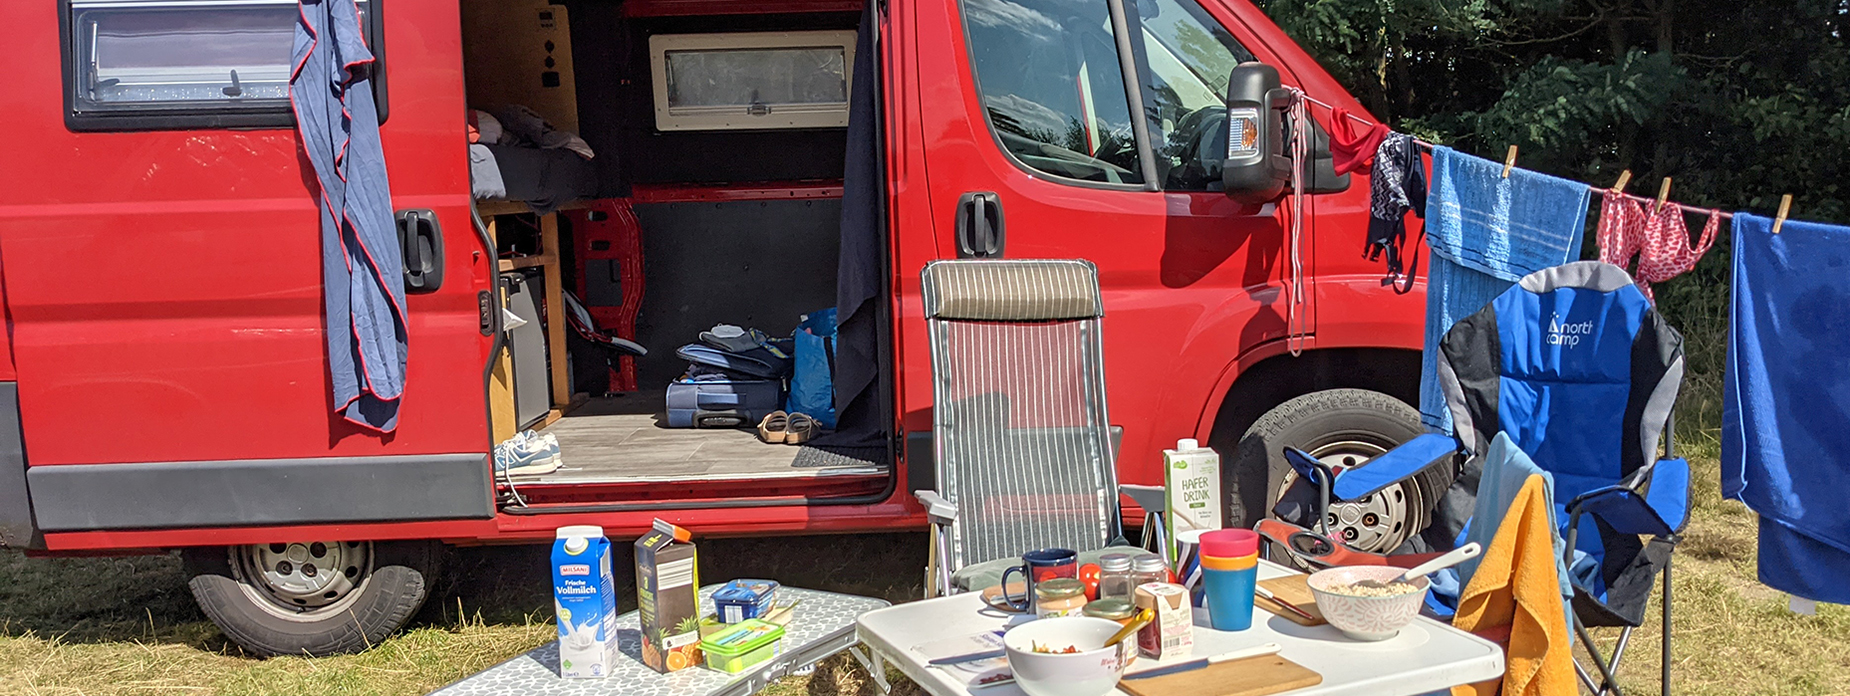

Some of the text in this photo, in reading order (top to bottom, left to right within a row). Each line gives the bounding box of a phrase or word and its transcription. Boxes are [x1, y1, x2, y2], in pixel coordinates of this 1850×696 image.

[1546, 333, 1579, 350] camp
[1182, 476, 1209, 490] HAFER
[1183, 489, 1210, 502] DRINK
[564, 579, 587, 587] Frische
[556, 585, 597, 595] Vollmilch
